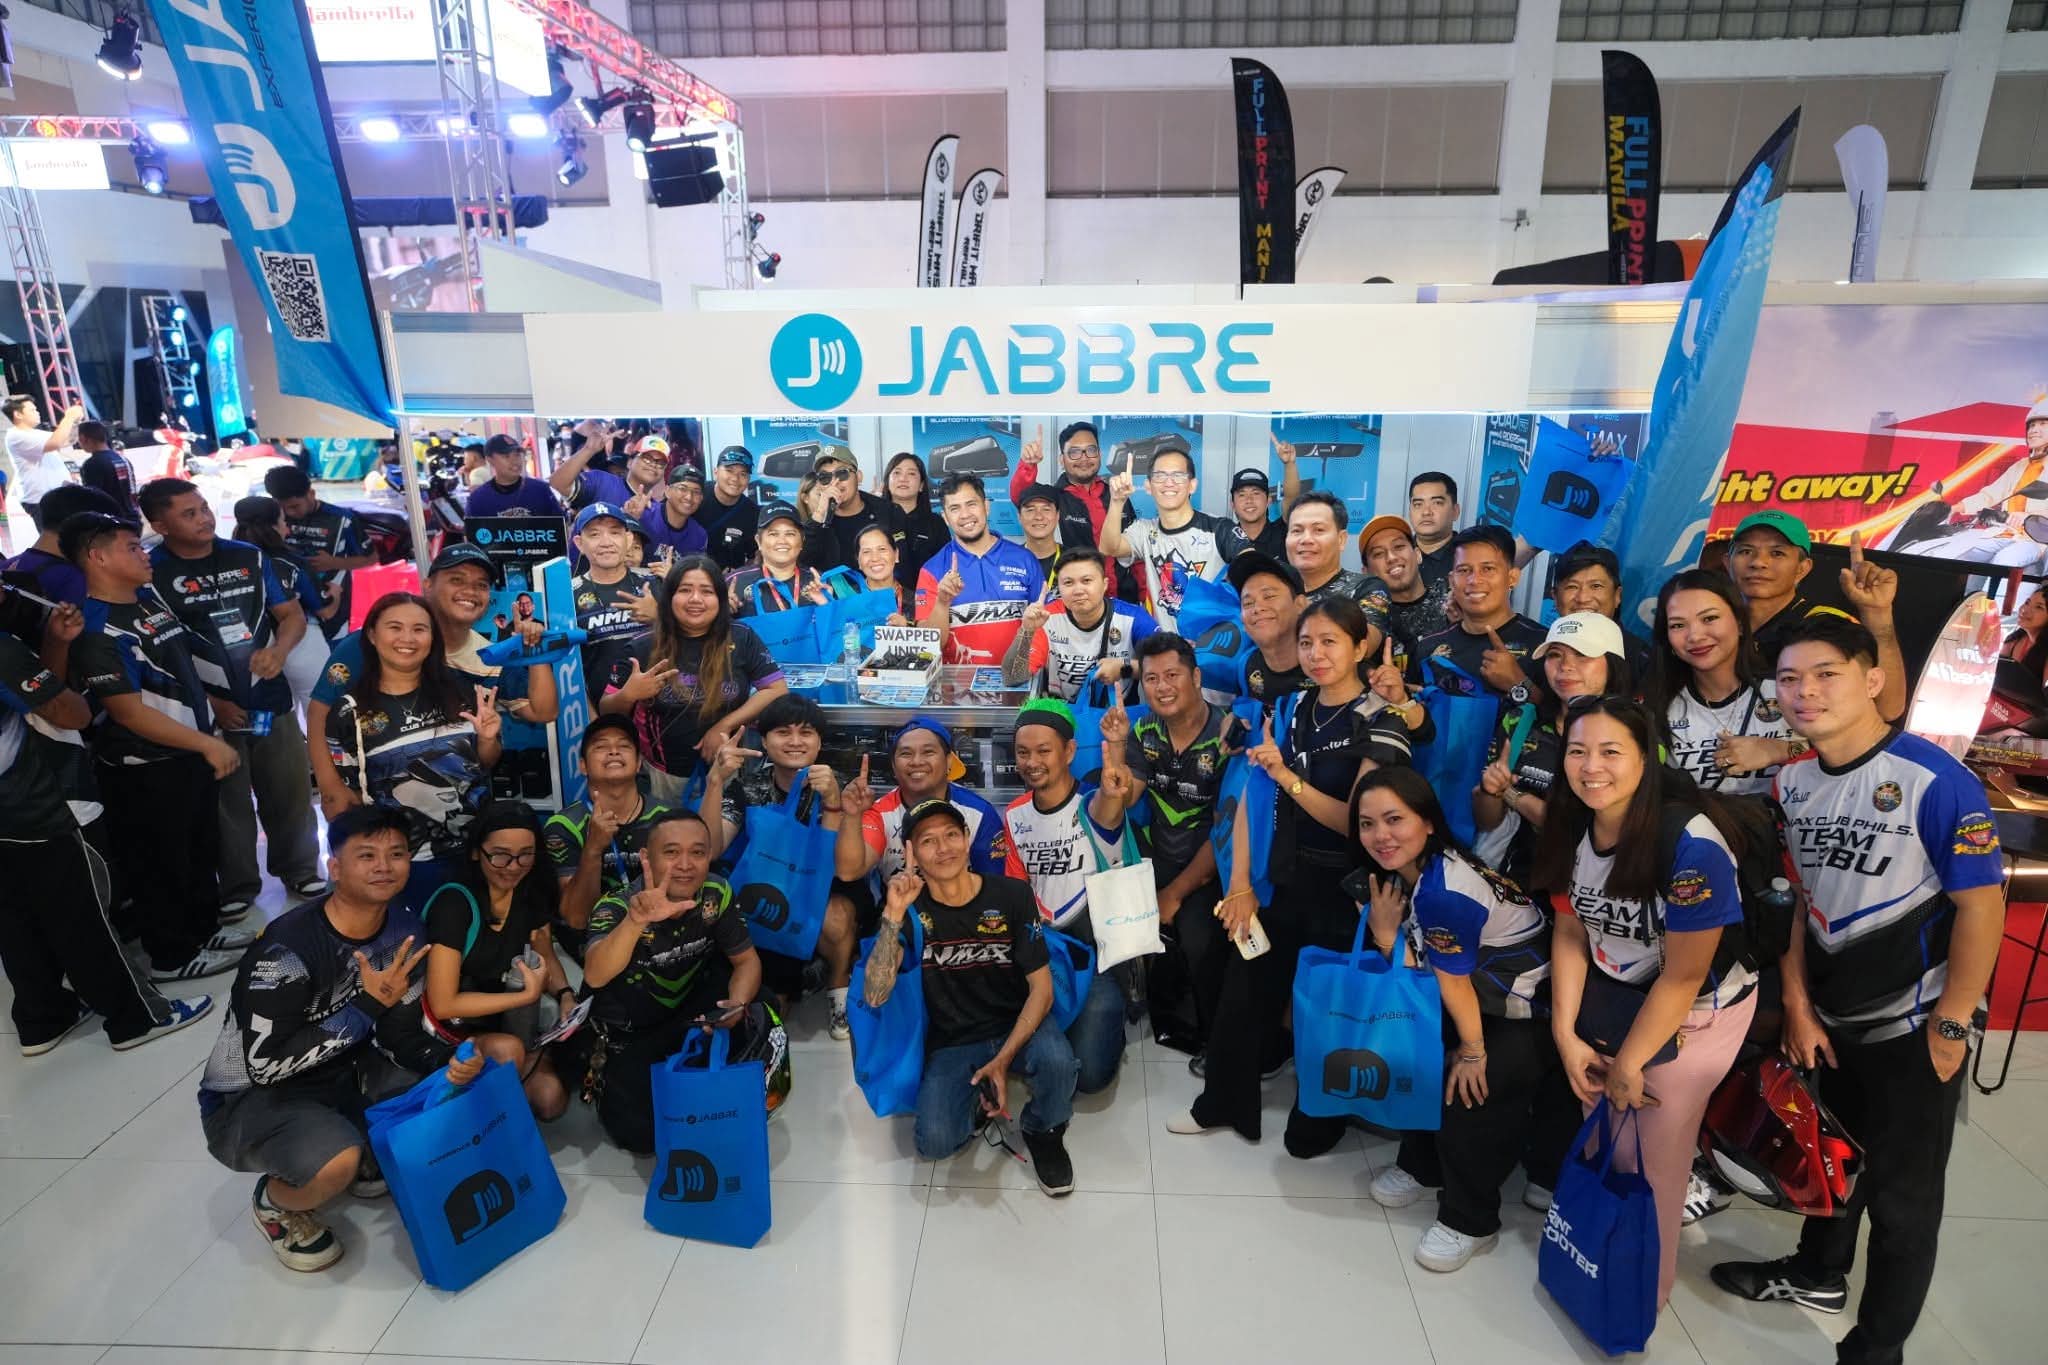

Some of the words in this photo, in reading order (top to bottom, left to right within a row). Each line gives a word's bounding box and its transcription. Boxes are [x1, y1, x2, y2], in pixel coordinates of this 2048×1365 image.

[1252, 78, 1267, 136] FULL
[1625, 116, 1649, 197] FULL
[1255, 137, 1270, 209] PRINT
[1608, 115, 1631, 233] MANILA
[1256, 223, 1272, 283] MANI
[878, 323, 1275, 396] JABBRE
[1779, 464, 1918, 505] away!
[494, 529, 558, 542] JABBRE
[875, 628, 940, 642] SWAPPED
[888, 645, 928, 658] UNITS
[1057, 660, 1097, 674] TEA
[1057, 670, 1089, 686] CE
[1676, 750, 1717, 767] TE
[1799, 828, 1878, 851] TEAM
[1026, 854, 1085, 876] CEBU
[922, 943, 1013, 966] NMAX
[1544, 1225, 1599, 1279] OOTER
